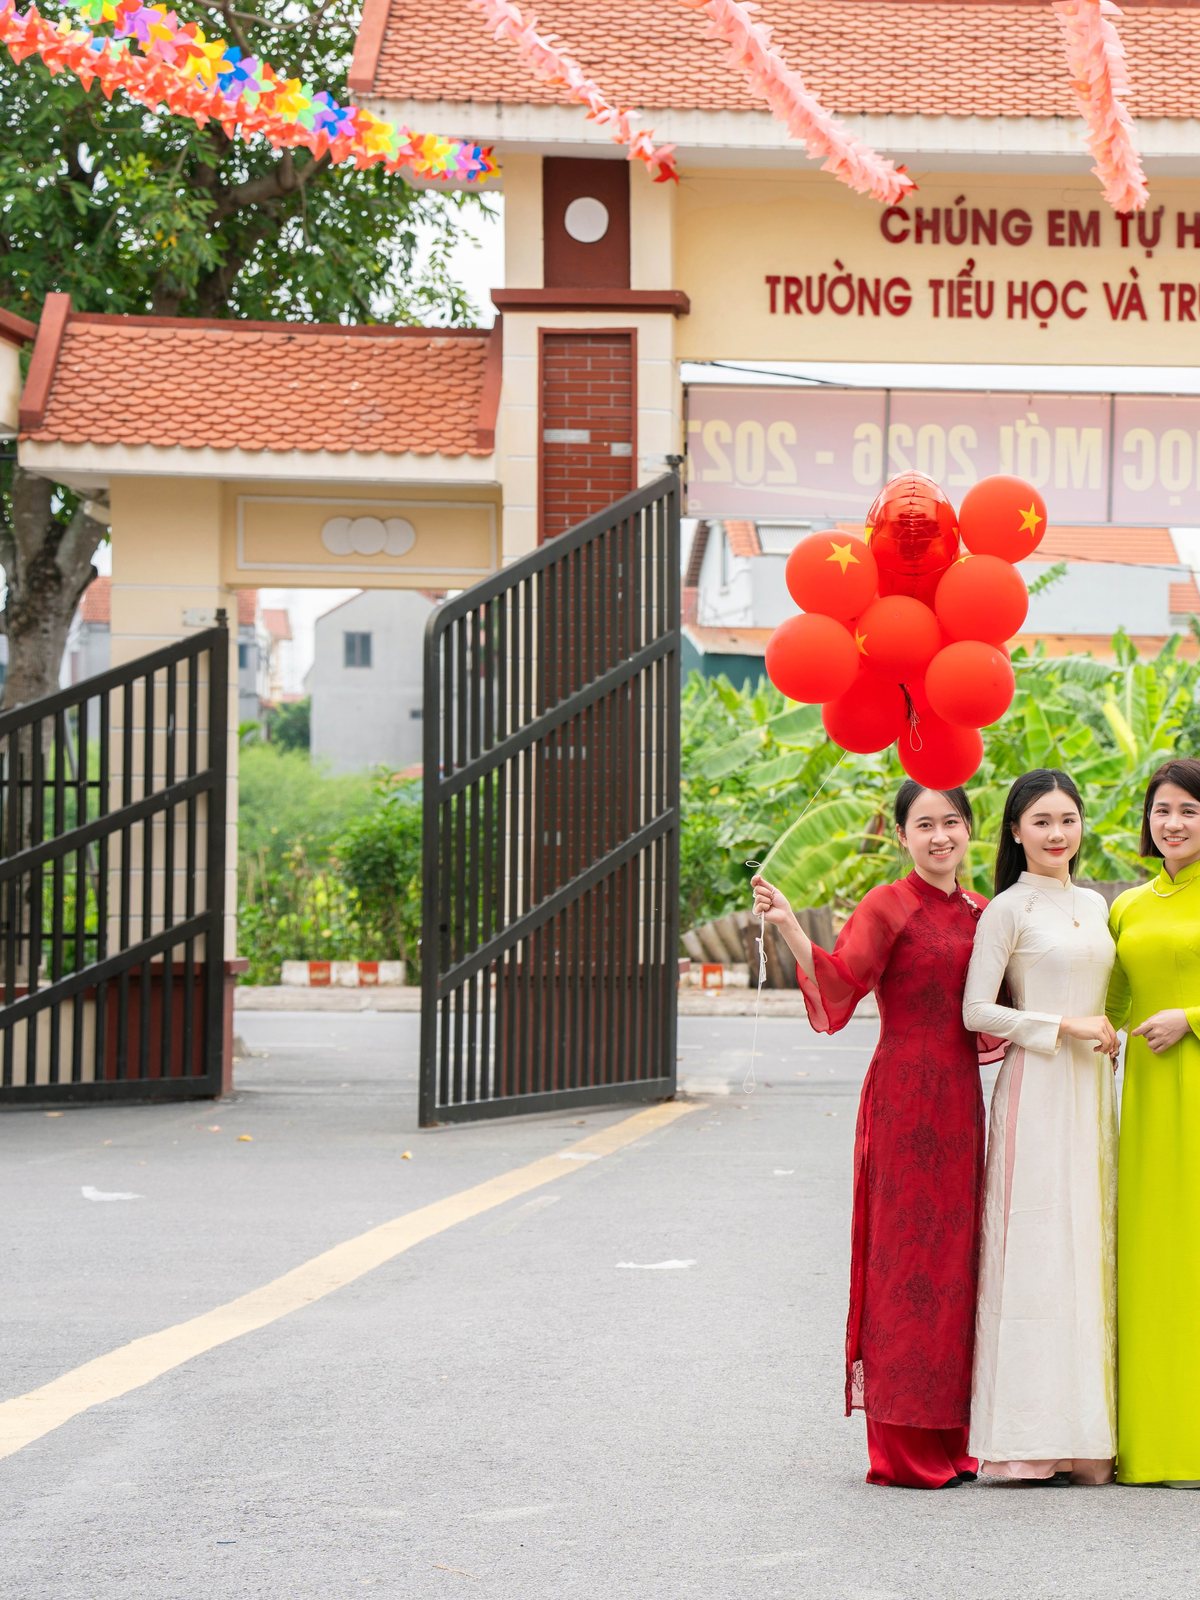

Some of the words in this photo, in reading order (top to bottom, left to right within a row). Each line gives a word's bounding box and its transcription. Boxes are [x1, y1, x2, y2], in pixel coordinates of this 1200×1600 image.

[880, 194, 1033, 247] CHÚNG
[1047, 209, 1100, 248] EM
[1114, 205, 1165, 258] TỰ
[765, 259, 912, 317] TRƯỜNG
[928, 258, 995, 319] TIỂU
[1007, 280, 1088, 329] HỌC
[1103, 267, 1148, 322] VÀ
